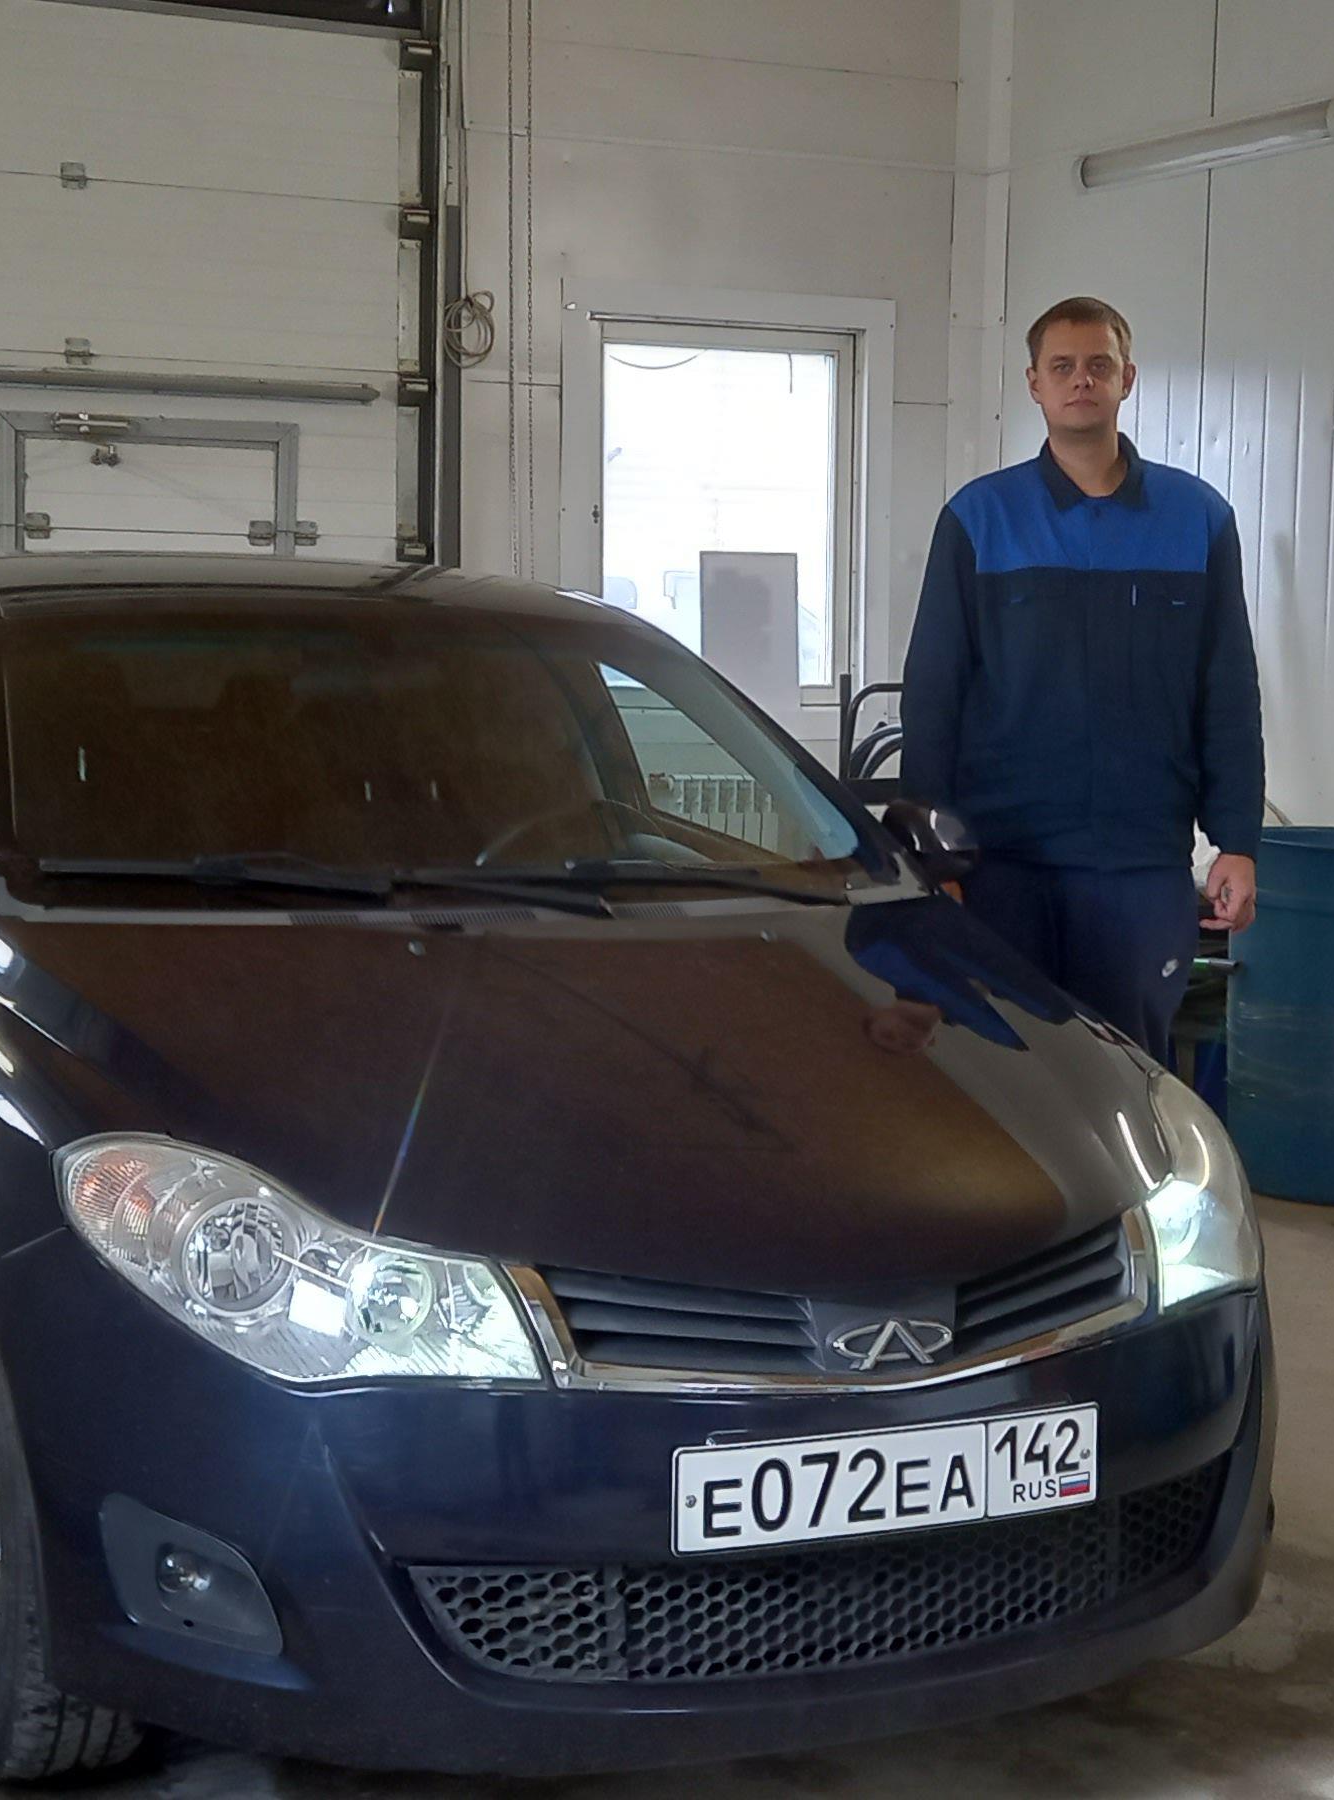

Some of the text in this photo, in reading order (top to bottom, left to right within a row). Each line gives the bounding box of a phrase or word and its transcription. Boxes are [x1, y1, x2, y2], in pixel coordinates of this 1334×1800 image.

[703, 1419, 1081, 1538] E072EA 142
[1013, 1479, 1057, 1503] RUS
